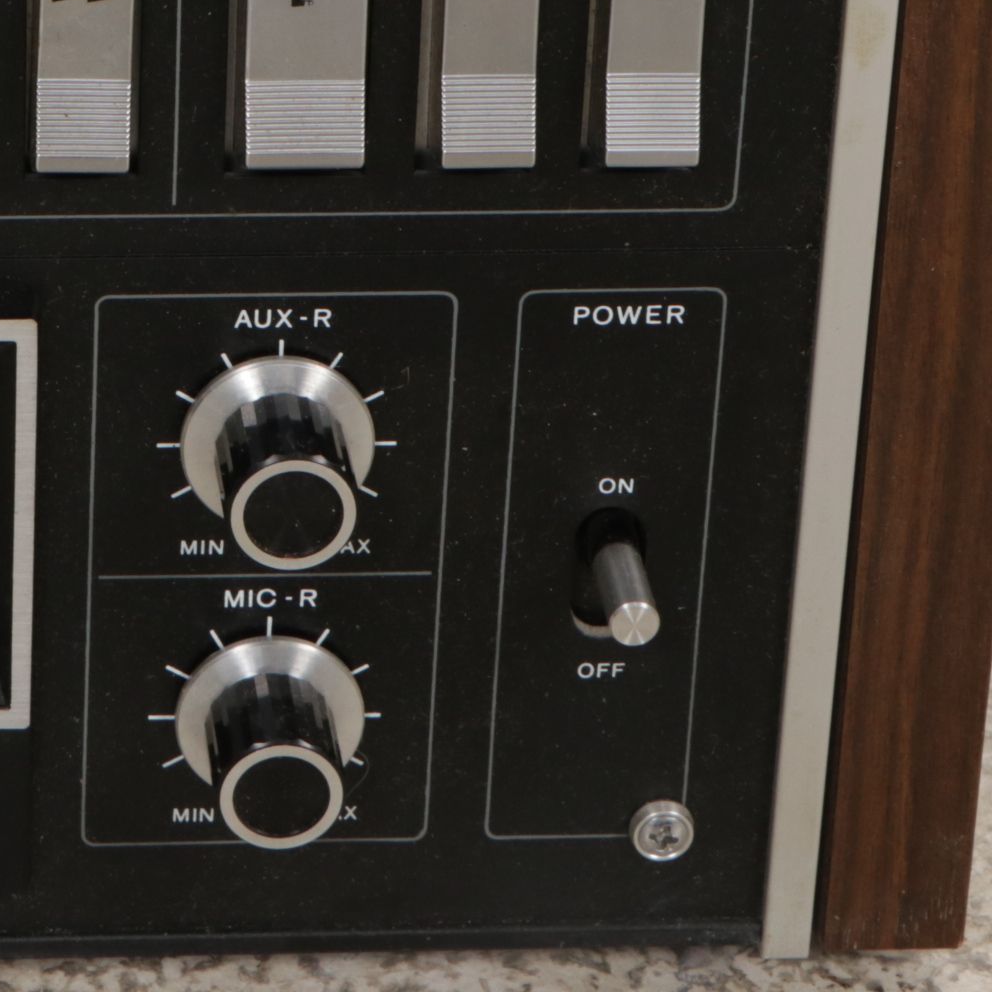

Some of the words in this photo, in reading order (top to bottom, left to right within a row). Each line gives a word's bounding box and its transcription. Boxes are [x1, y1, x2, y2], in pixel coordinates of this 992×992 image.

[572, 305, 686, 326] POWER
[598, 477, 635, 495] ON
[180, 539, 225, 556] MIN
[340, 538, 371, 555] AX
[576, 662, 626, 680] OFF
[172, 807, 216, 823] MIN
